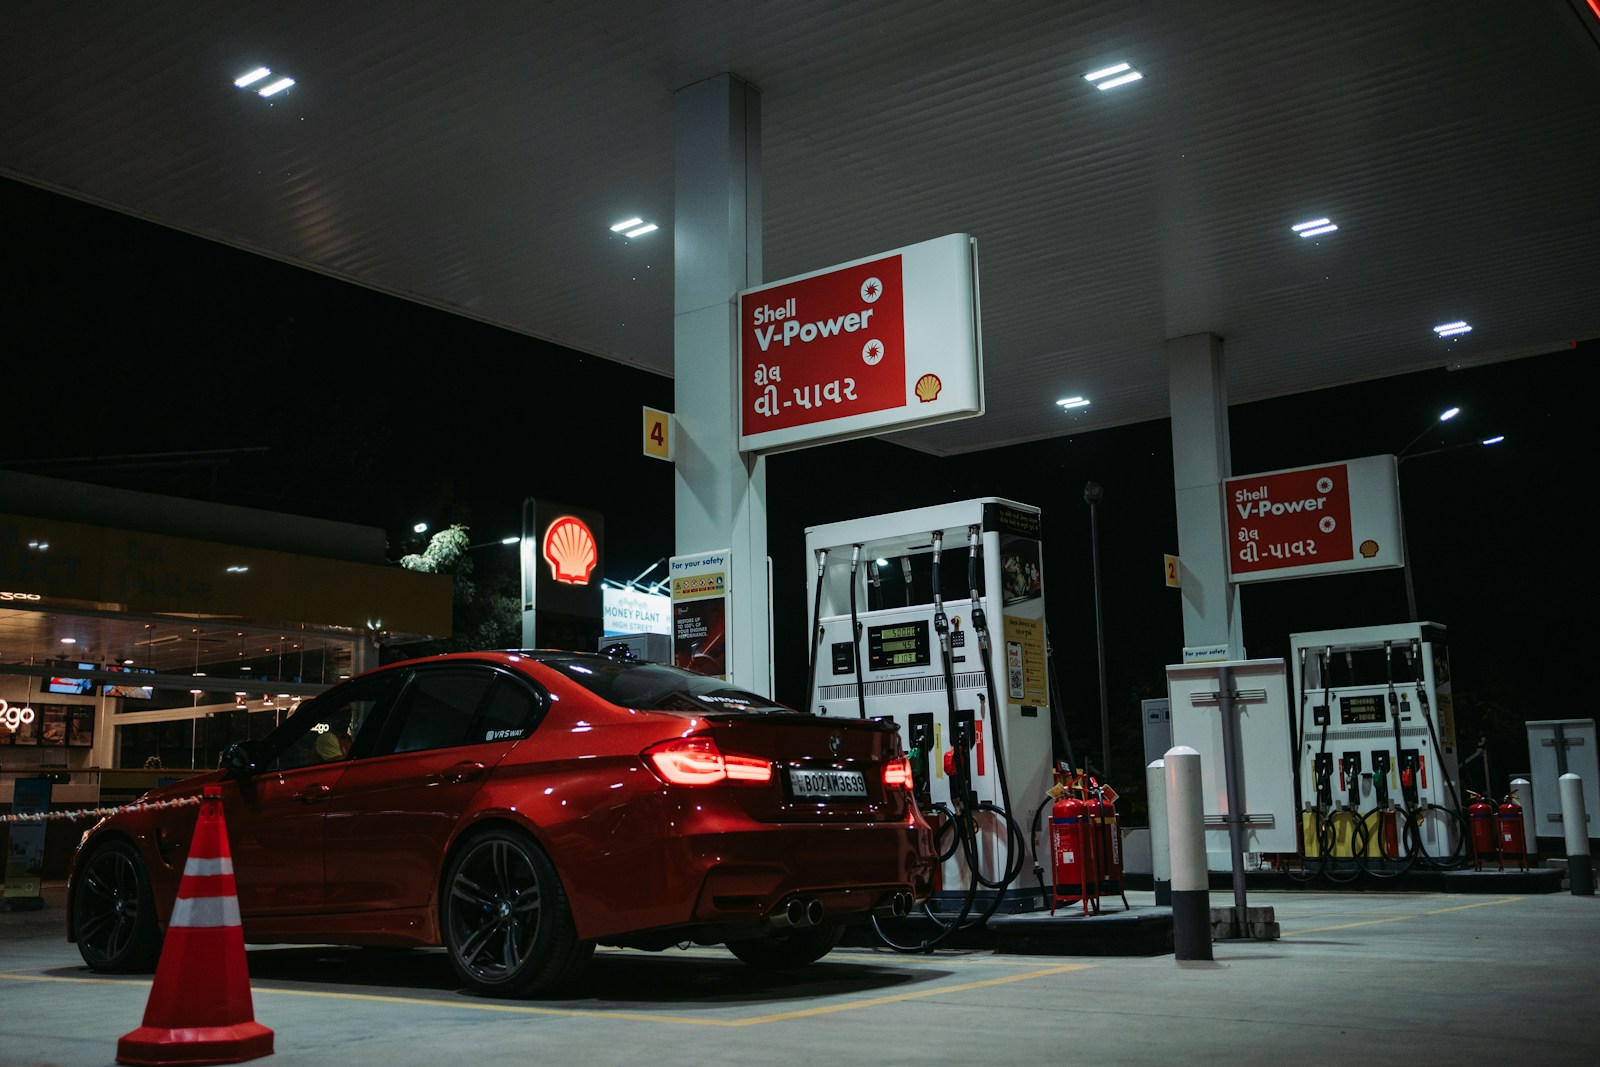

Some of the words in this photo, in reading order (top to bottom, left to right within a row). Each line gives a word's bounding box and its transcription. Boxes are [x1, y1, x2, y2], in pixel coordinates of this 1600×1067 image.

[753, 297, 796, 325] Shell
[753, 307, 873, 352] V-Power
[754, 363, 781, 386] શેલ
[650, 421, 664, 446] 4
[1235, 486, 1268, 502] Shell
[1236, 495, 1327, 520] V-Power
[1238, 527, 1259, 542] શેલ
[684, 560, 700, 569] your
[702, 556, 724, 565] safety
[1168, 562, 1175, 579] 2
[605, 606, 632, 619] MONEY
[635, 610, 660, 623] PLANT
[612, 620, 628, 629] HIGH
[630, 622, 653, 632] STREET
